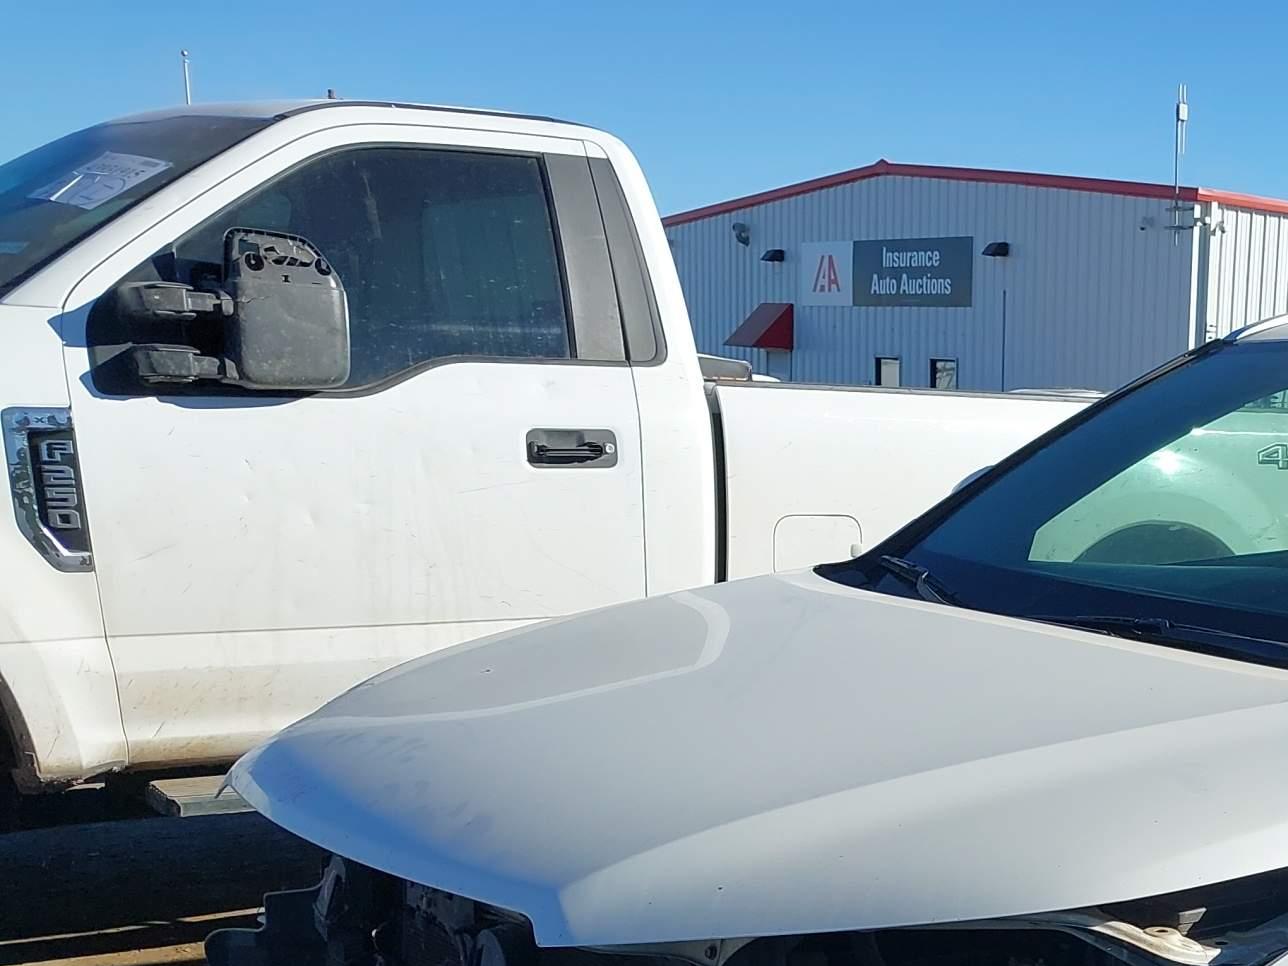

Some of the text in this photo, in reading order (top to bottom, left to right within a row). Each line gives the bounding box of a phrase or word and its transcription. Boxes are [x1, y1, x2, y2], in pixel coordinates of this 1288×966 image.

[882, 246, 941, 268] Insurance
[870, 273, 952, 295] Auto Auctions
